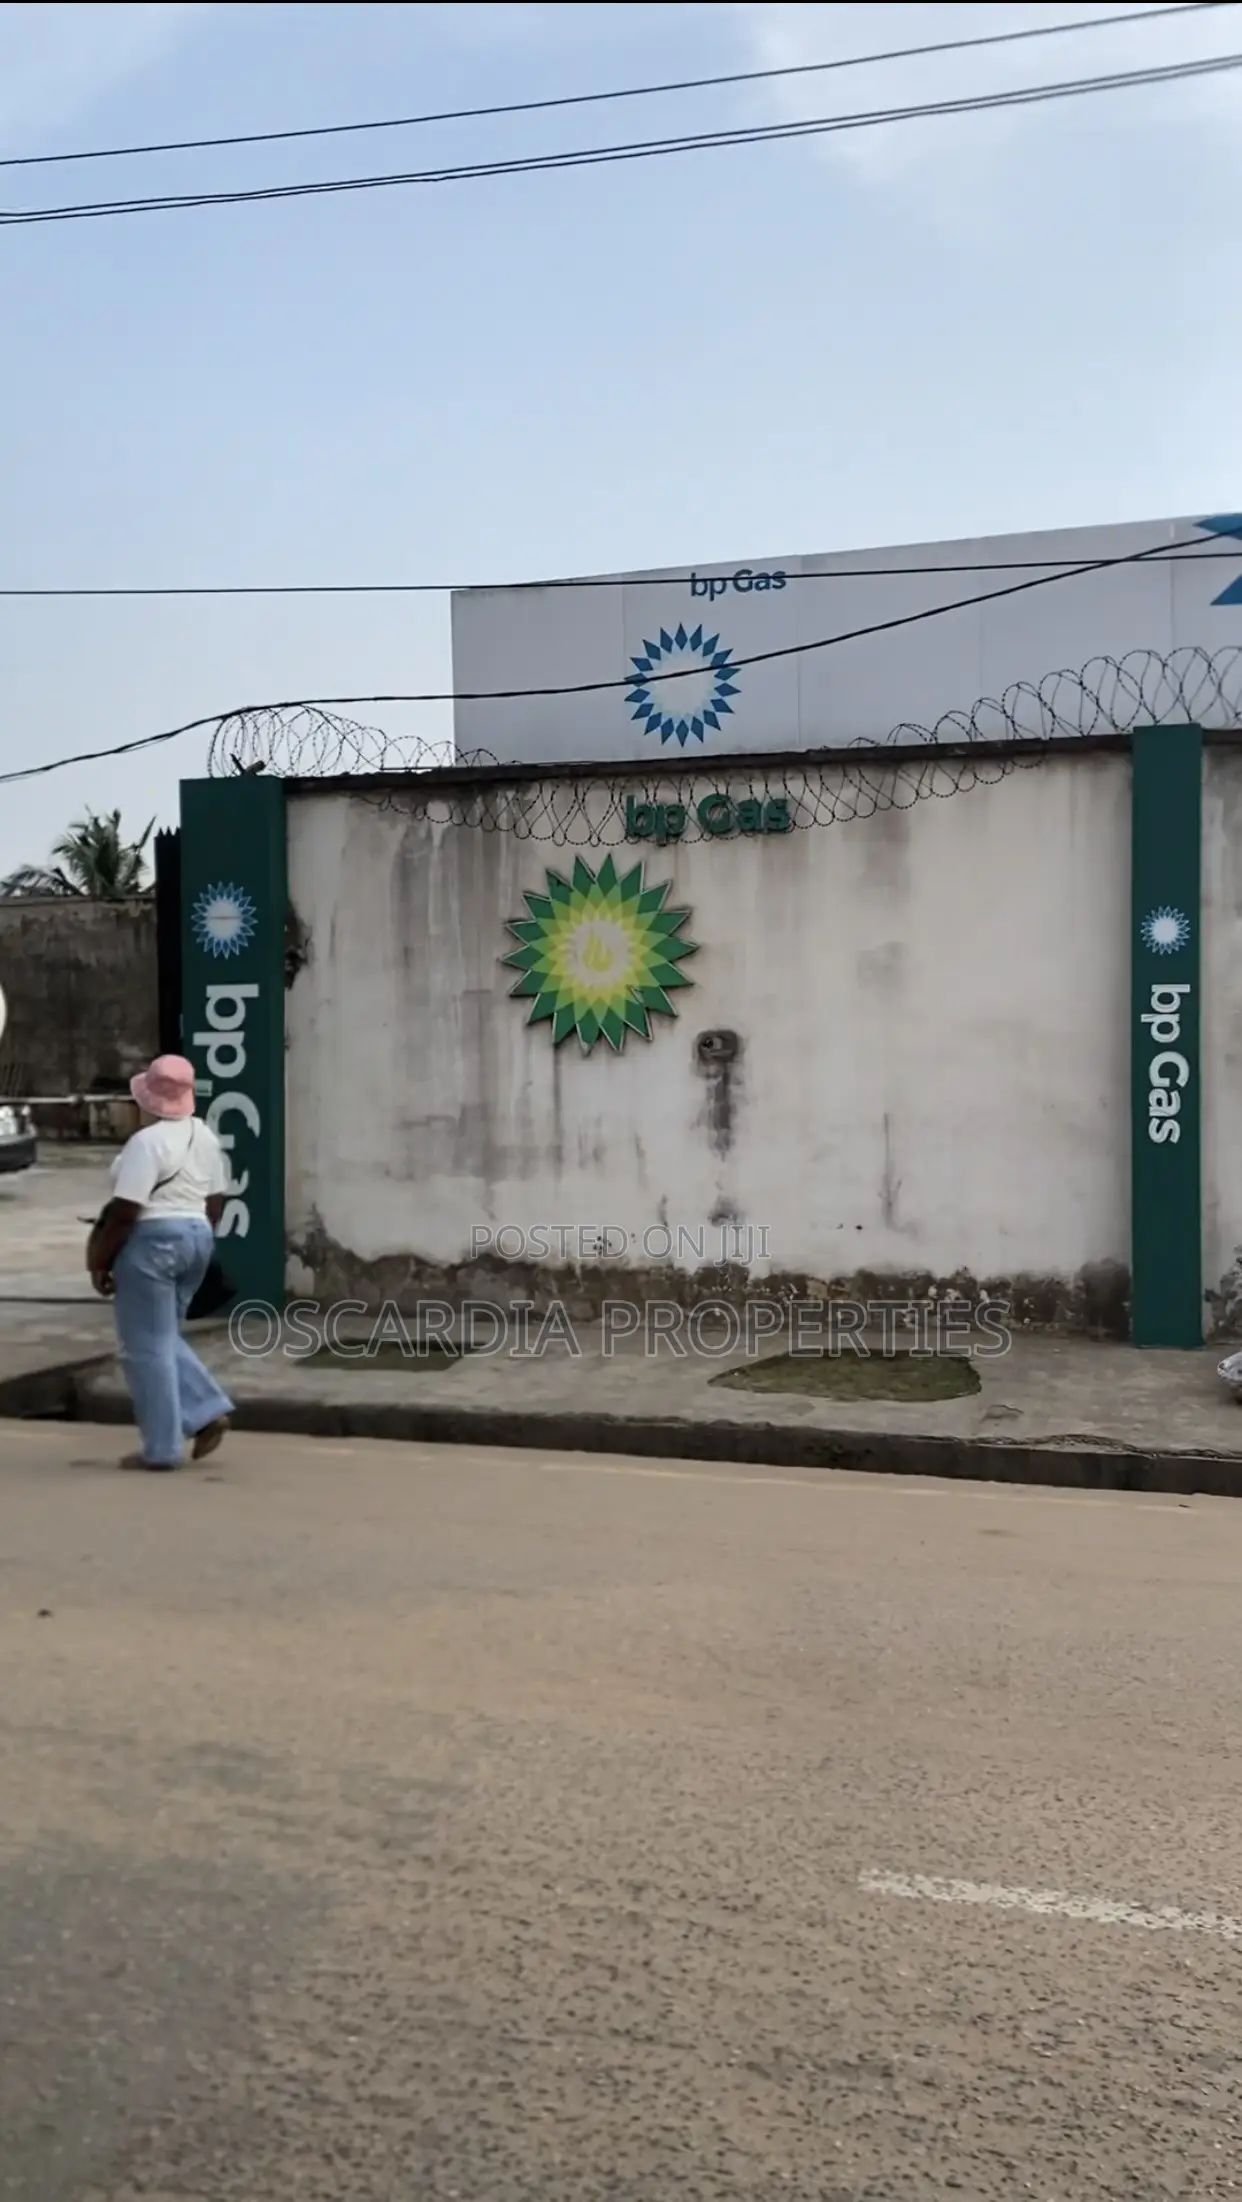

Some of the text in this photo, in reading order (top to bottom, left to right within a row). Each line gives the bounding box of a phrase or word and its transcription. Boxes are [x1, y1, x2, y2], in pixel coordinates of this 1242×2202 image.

[691, 569, 786, 601] bp Gas
[626, 794, 790, 846] bp Gas
[193, 984, 259, 1078] bp
[1141, 984, 1190, 1143] bp Gas
